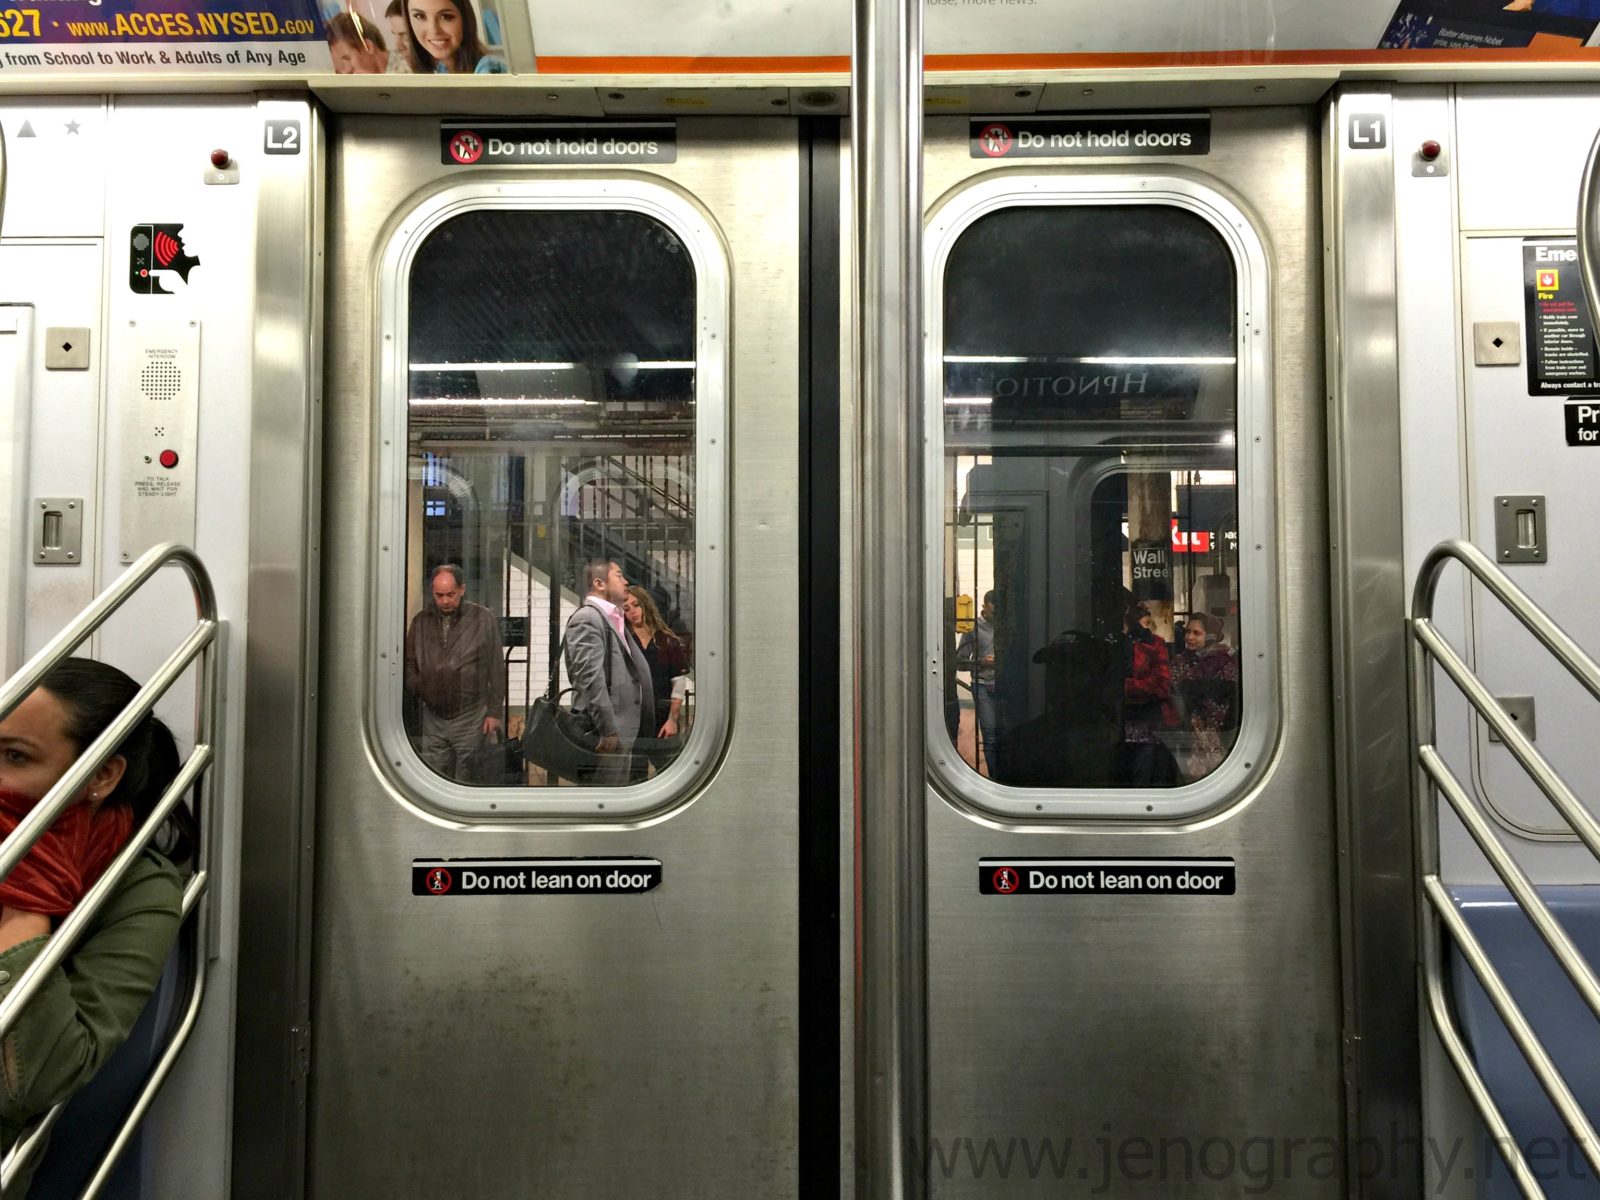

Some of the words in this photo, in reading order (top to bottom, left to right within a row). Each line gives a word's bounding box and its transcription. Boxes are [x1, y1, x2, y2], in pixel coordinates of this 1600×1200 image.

[5, 52, 41, 66] from
[43, 51, 95, 66] School
[99, 52, 114, 65] to
[116, 51, 156, 65] Work
[159, 51, 171, 64] &
[175, 50, 223, 64] Adults
[226, 50, 242, 64] of
[246, 50, 273, 66] Any
[278, 50, 306, 66] Age
[266, 126, 298, 149] L2
[1018, 131, 1045, 148] Do
[1050, 131, 1082, 148] not
[1087, 130, 1129, 148] hold
[1135, 130, 1192, 147] doors
[1353, 120, 1381, 143] L1
[488, 139, 515, 156] Do
[520, 139, 552, 156] not
[556, 138, 598, 156] hold
[602, 138, 659, 156] doors
[1535, 246, 1578, 262] Eme
[1538, 292, 1554, 300] Fire
[1578, 405, 1600, 423] Pr
[1578, 427, 1599, 441] for
[1133, 550, 1165, 565] Wall
[1133, 566, 1169, 579] Stree
[462, 871, 490, 890] Do
[493, 871, 526, 889] not
[531, 870, 572, 889] lean
[576, 873, 602, 889] on
[605, 870, 652, 888] door
[1029, 871, 1058, 889] Do
[1061, 871, 1095, 889] not
[1101, 870, 1142, 889] lean
[1146, 873, 1172, 889] on
[1176, 871, 1223, 889] door
